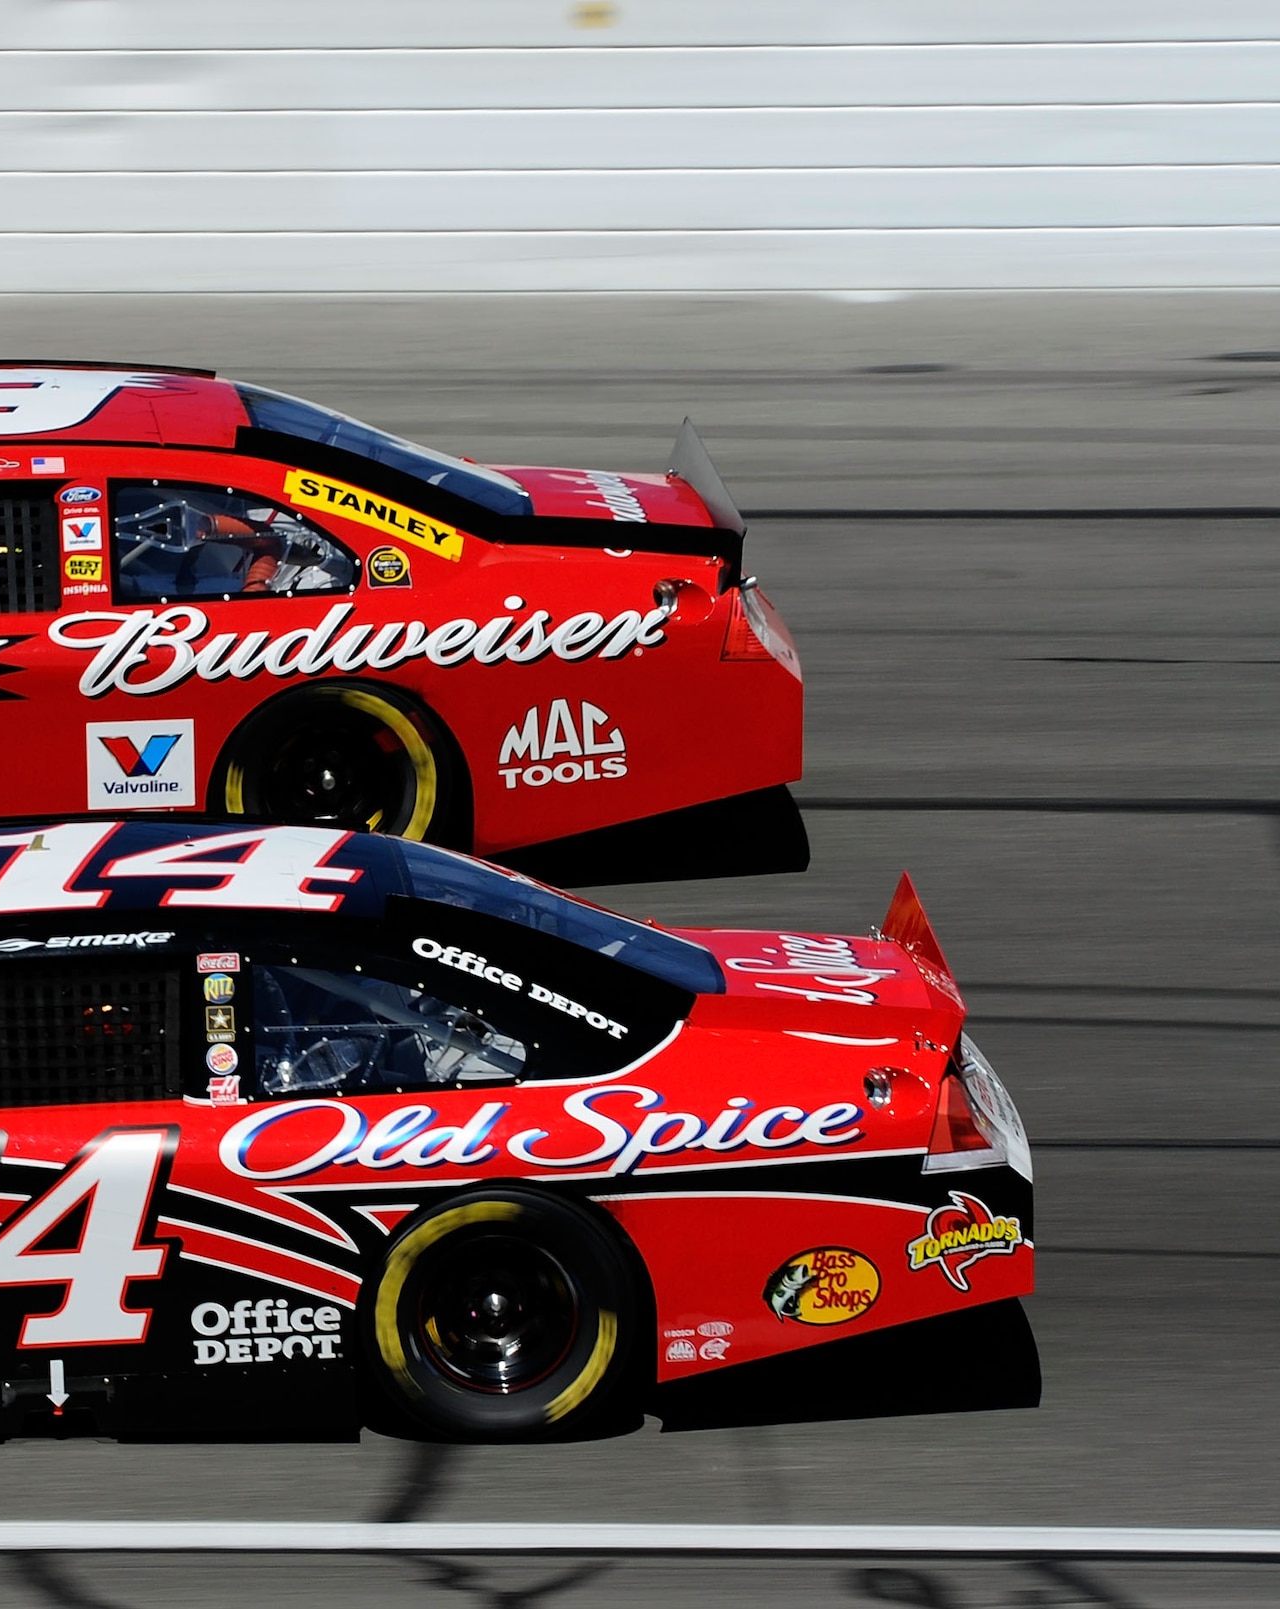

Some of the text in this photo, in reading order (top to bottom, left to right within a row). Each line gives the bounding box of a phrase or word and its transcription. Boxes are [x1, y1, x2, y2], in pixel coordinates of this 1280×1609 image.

[66, 491, 93, 502] Ford
[299, 478, 453, 547] STANLEY
[69, 560, 100, 576] BEST BUY
[63, 584, 109, 595] INSIGNIA
[48, 595, 670, 697] Budweiser
[498, 698, 626, 765] MAC
[103, 780, 179, 794] Valvoline
[498, 756, 628, 789] TOOLS
[203, 977, 234, 1001] RITZ
[411, 937, 629, 1040] Office DEPOT
[219, 1085, 863, 1180] Old Spice
[912, 1218, 1019, 1265] TORNADOS
[811, 1250, 857, 1270] Bass
[811, 1268, 848, 1289] Pro
[812, 1286, 872, 1312] Shops
[190, 1298, 342, 1337] Office
[192, 1334, 342, 1365] DEPOT
